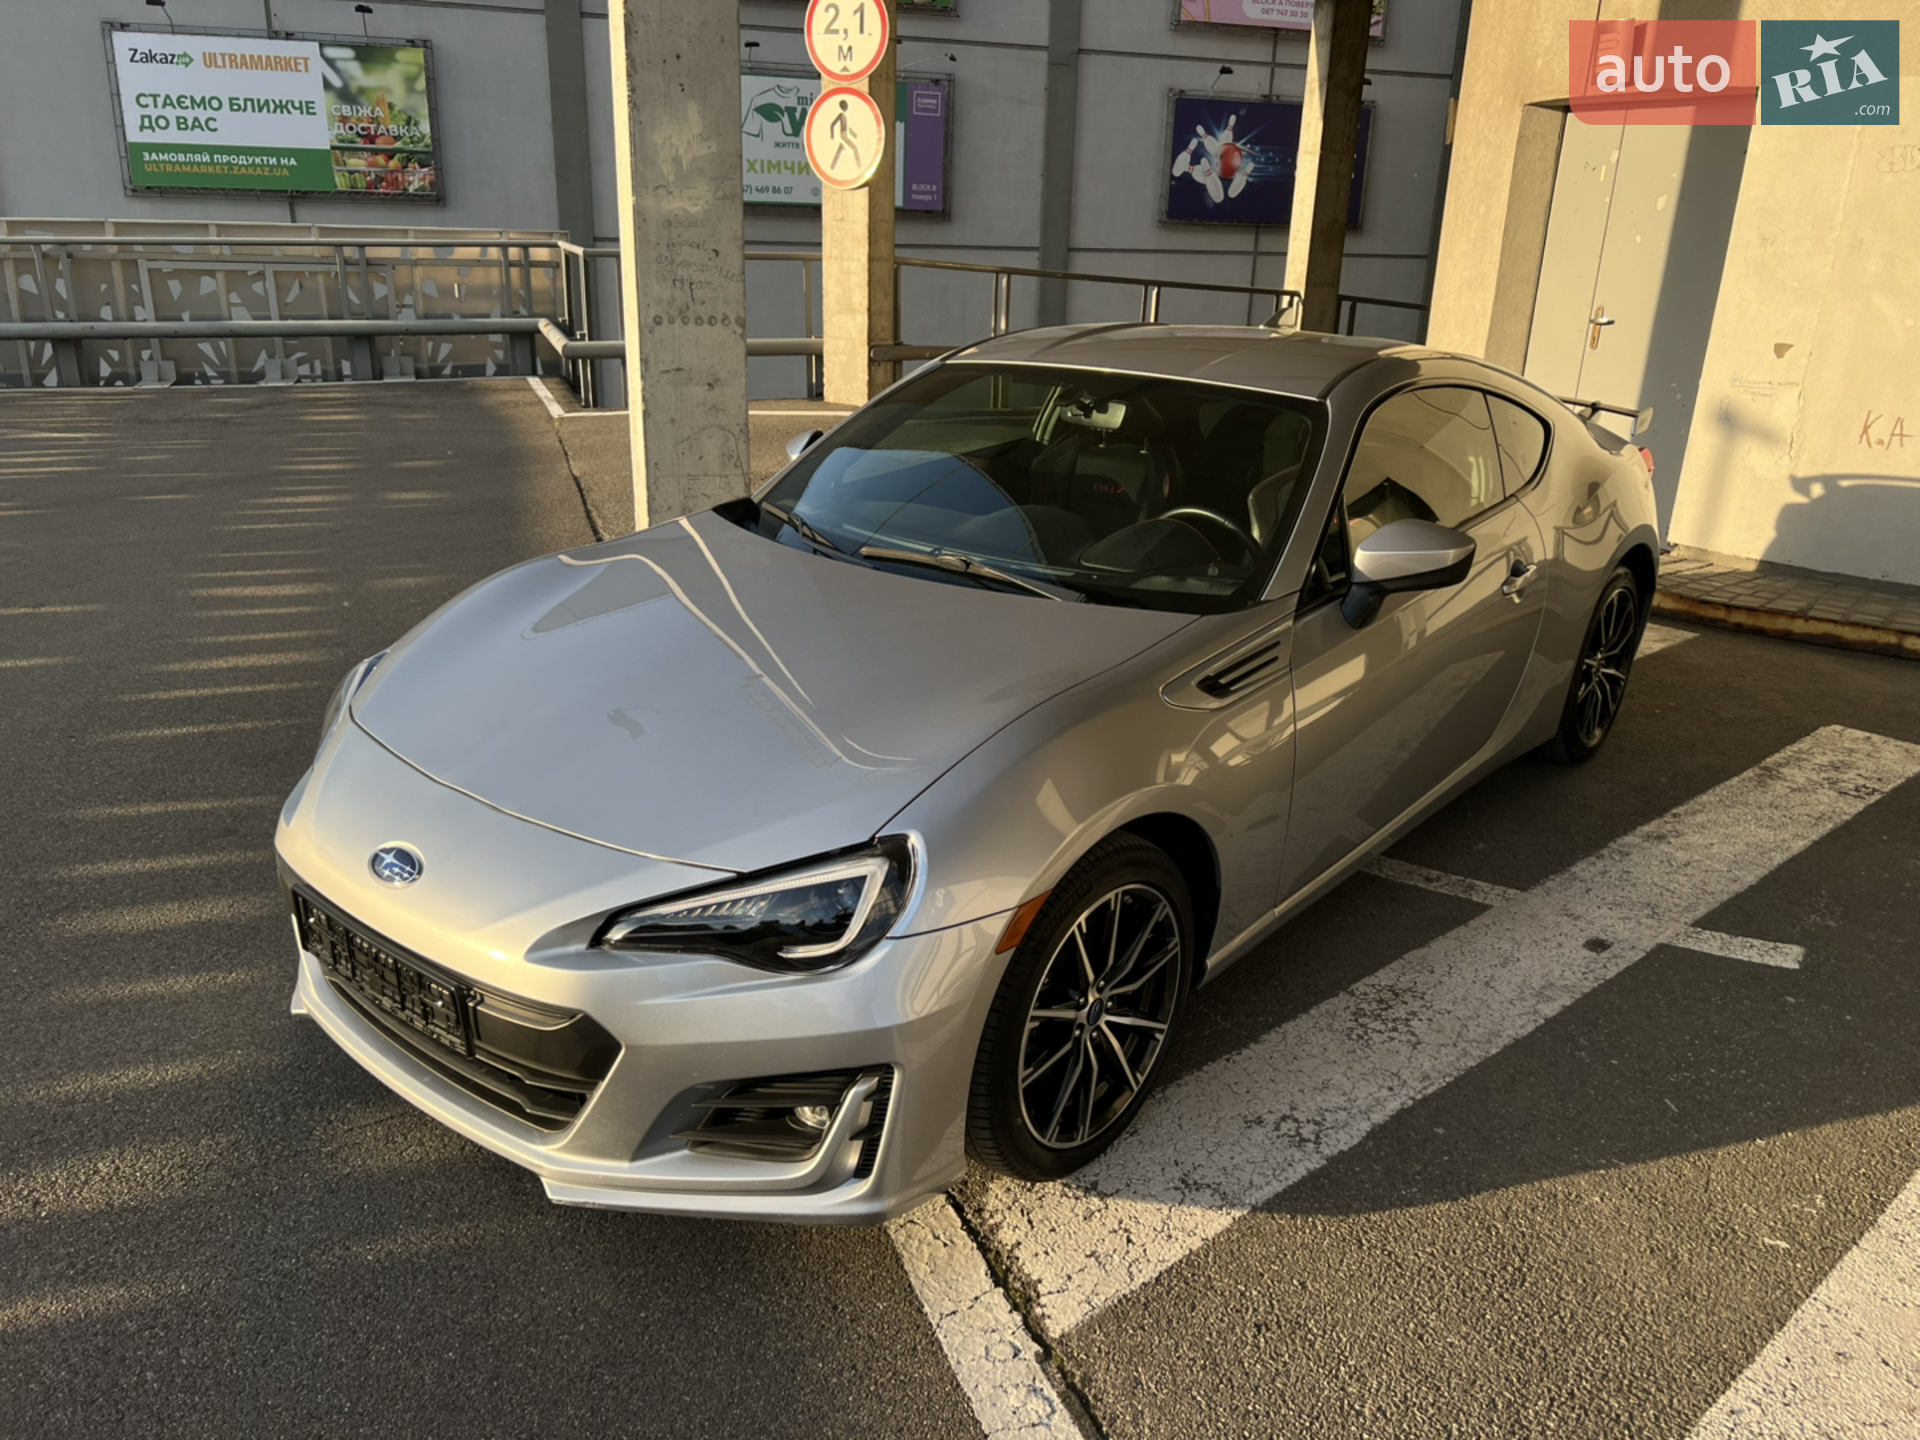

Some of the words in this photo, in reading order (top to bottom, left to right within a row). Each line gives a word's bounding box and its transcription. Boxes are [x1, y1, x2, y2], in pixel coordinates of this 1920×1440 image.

[823, 3, 866, 40] 2,1
[202, 52, 310, 73] ULTRAMARKET
[135, 93, 223, 111] СТАЄМО
[228, 97, 317, 116] БЛИЖЧЕ
[331, 104, 384, 118] СВІЖА
[139, 115, 170, 132] ДО
[175, 115, 218, 132] ВАС
[333, 122, 420, 137] ДОСТАВКА
[142, 152, 210, 163] ЗАМОВЛЯЙ
[213, 154, 277, 165] ПРОДУКТИ
[280, 157, 298, 166] НА
[745, 158, 813, 176] ХІМЧИ
[144, 162, 290, 176] ULTRAMARKET.ZAKAZ.UA
[755, 185, 770, 194] 469
[772, 185, 782, 194] 86
[784, 186, 793, 195] 07
